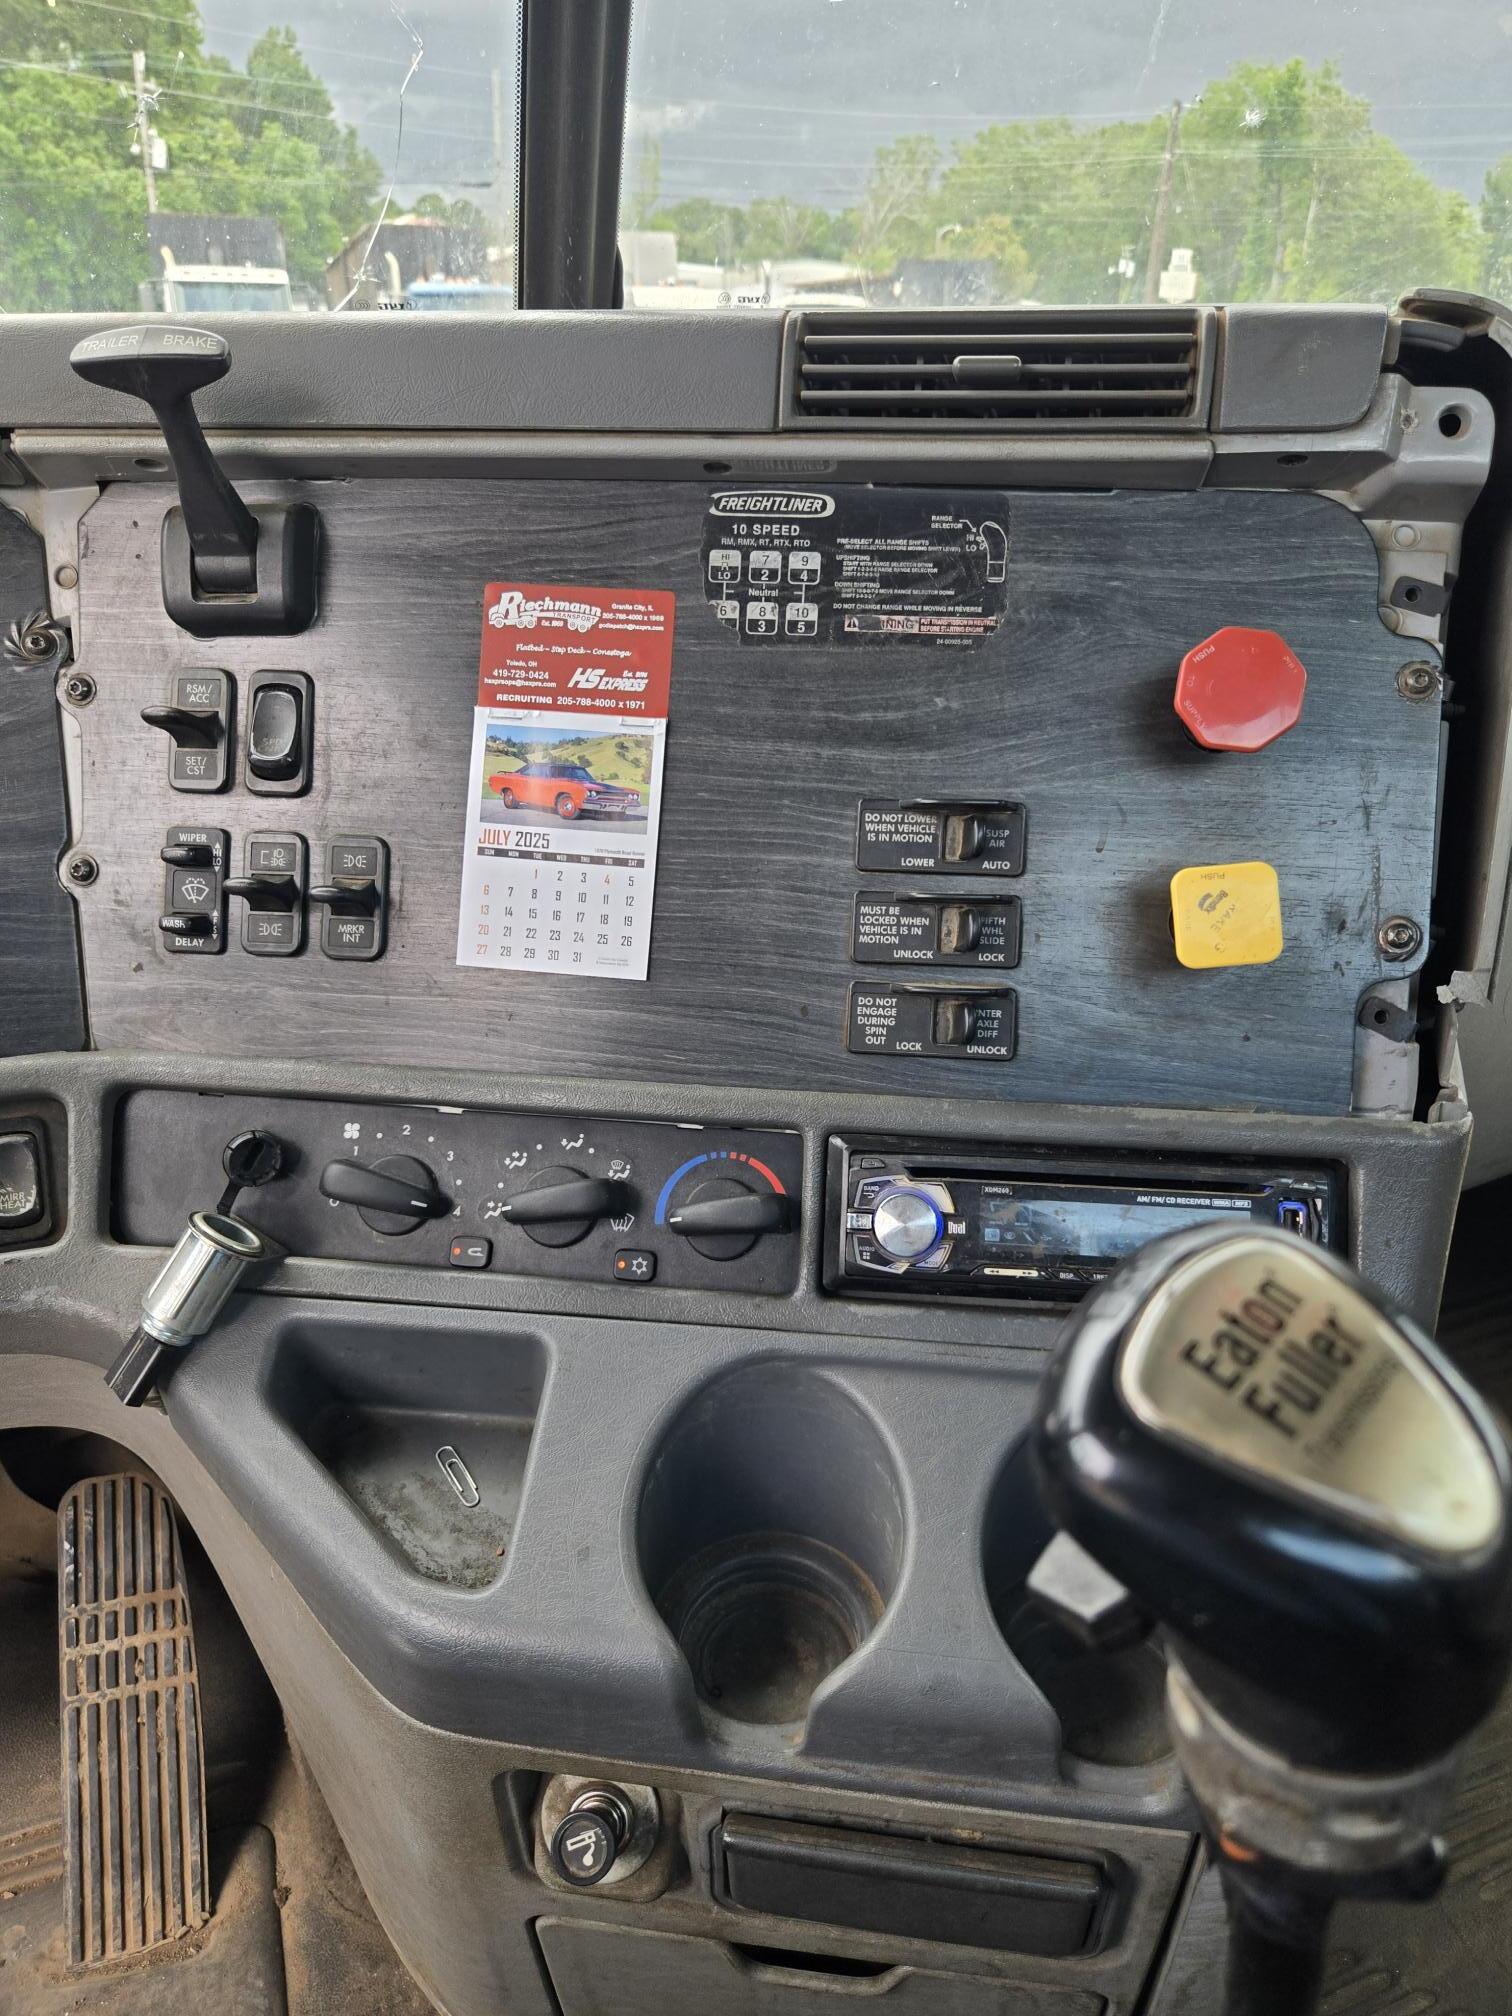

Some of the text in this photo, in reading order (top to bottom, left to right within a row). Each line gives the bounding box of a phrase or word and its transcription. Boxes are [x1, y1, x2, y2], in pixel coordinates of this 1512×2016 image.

[82, 334, 219, 352] TRAILER BRAKE
[718, 497, 823, 513] FREIGHTLINER
[732, 524, 801, 536] 10 SPEED
[794, 539, 811, 547] RTO
[762, 555, 770, 566] 7
[802, 556, 809, 566] 9
[761, 570, 769, 581] 2
[800, 570, 808, 581] 4
[748, 588, 779, 597] Neutral
[498, 591, 602, 619] Riechmann
[720, 606, 727, 616] 6
[759, 607, 767, 617] 8
[795, 608, 809, 618] 10
[552, 612, 596, 623] TRANSPORT
[758, 621, 766, 632] 3
[797, 622, 805, 633] 5
[516, 643, 545, 652] Flatbed
[1192, 645, 1215, 664] PUSH
[493, 669, 549, 680] 419-729-0424
[568, 668, 606, 689] HS
[187, 684, 212, 694] RSM/
[598, 678, 648, 692] EXPRESS
[189, 694, 210, 703] ACC
[496, 694, 553, 704] RECRUITING
[557, 696, 616, 708] 205-788-4000
[626, 700, 646, 710] 1971
[1184, 699, 1208, 729] SUPPLY
[185, 756, 206, 765] SET/
[187, 766, 206, 775] CST
[865, 813, 938, 823] DO NOT LOWER
[865, 823, 936, 833] WHEN VEHICLE
[179, 833, 207, 842] WIPER
[868, 833, 933, 843] IS IN MOTION
[986, 829, 1010, 838] SUSP
[478, 829, 551, 849] JULY 2025
[989, 840, 1005, 848] AIR
[213, 849, 222, 857] HI
[213, 858, 222, 866] LO
[901, 858, 935, 867] LOWER
[982, 861, 1010, 870] AUTO
[534, 869, 634, 887] 1 2 3 4 5
[1201, 872, 1225, 880] PUSH
[483, 884, 634, 907] 6 7 8 9 10 11 12
[481, 904, 633, 927] 13 14 15 16 17 18 19
[860, 906, 900, 915] MUST BE
[213, 916, 218, 925] F
[860, 916, 930, 926] LOCKED WHEN
[213, 926, 218, 934] S
[338, 924, 365, 934] MRKR
[860, 926, 922, 935] VEHICLE IS IN
[982, 927, 1004, 935] WHL
[343, 934, 361, 943] INT
[478, 924, 633, 947] 20 21 22 23 24 25 26
[859, 936, 899, 944] MOTION
[979, 936, 1005, 945] SLIDE
[175, 938, 204, 947] DELAY
[477, 944, 582, 963] 27 28 29 30 31
[894, 950, 934, 959] UNLOCK
[979, 953, 1004, 962] LOCK
[858, 997, 897, 1007] DO NOT
[857, 1007, 897, 1016] ENGAGE
[857, 1017, 896, 1026] DURING
[976, 1020, 999, 1028] AXLE
[865, 1026, 887, 1035] SPIN
[977, 1030, 998, 1038] DIFF
[865, 1036, 886, 1045] OUT
[896, 1042, 922, 1051] LOCK
[967, 1045, 1008, 1055] UNLOCK
[402, 1125, 411, 1135] 2
[353, 1146, 359, 1156] 1
[447, 1151, 454, 1161] 3
[0, 1192, 25, 1201] MIRR
[1176, 1197, 1211, 1205] RECEIVER
[0, 1200, 25, 1210] HEAT
[452, 1206, 461, 1217] 4
[948, 1221, 966, 1234] Dual
[1179, 1276, 1302, 1391] Eaton
[1238, 1307, 1365, 1439] Fuller
